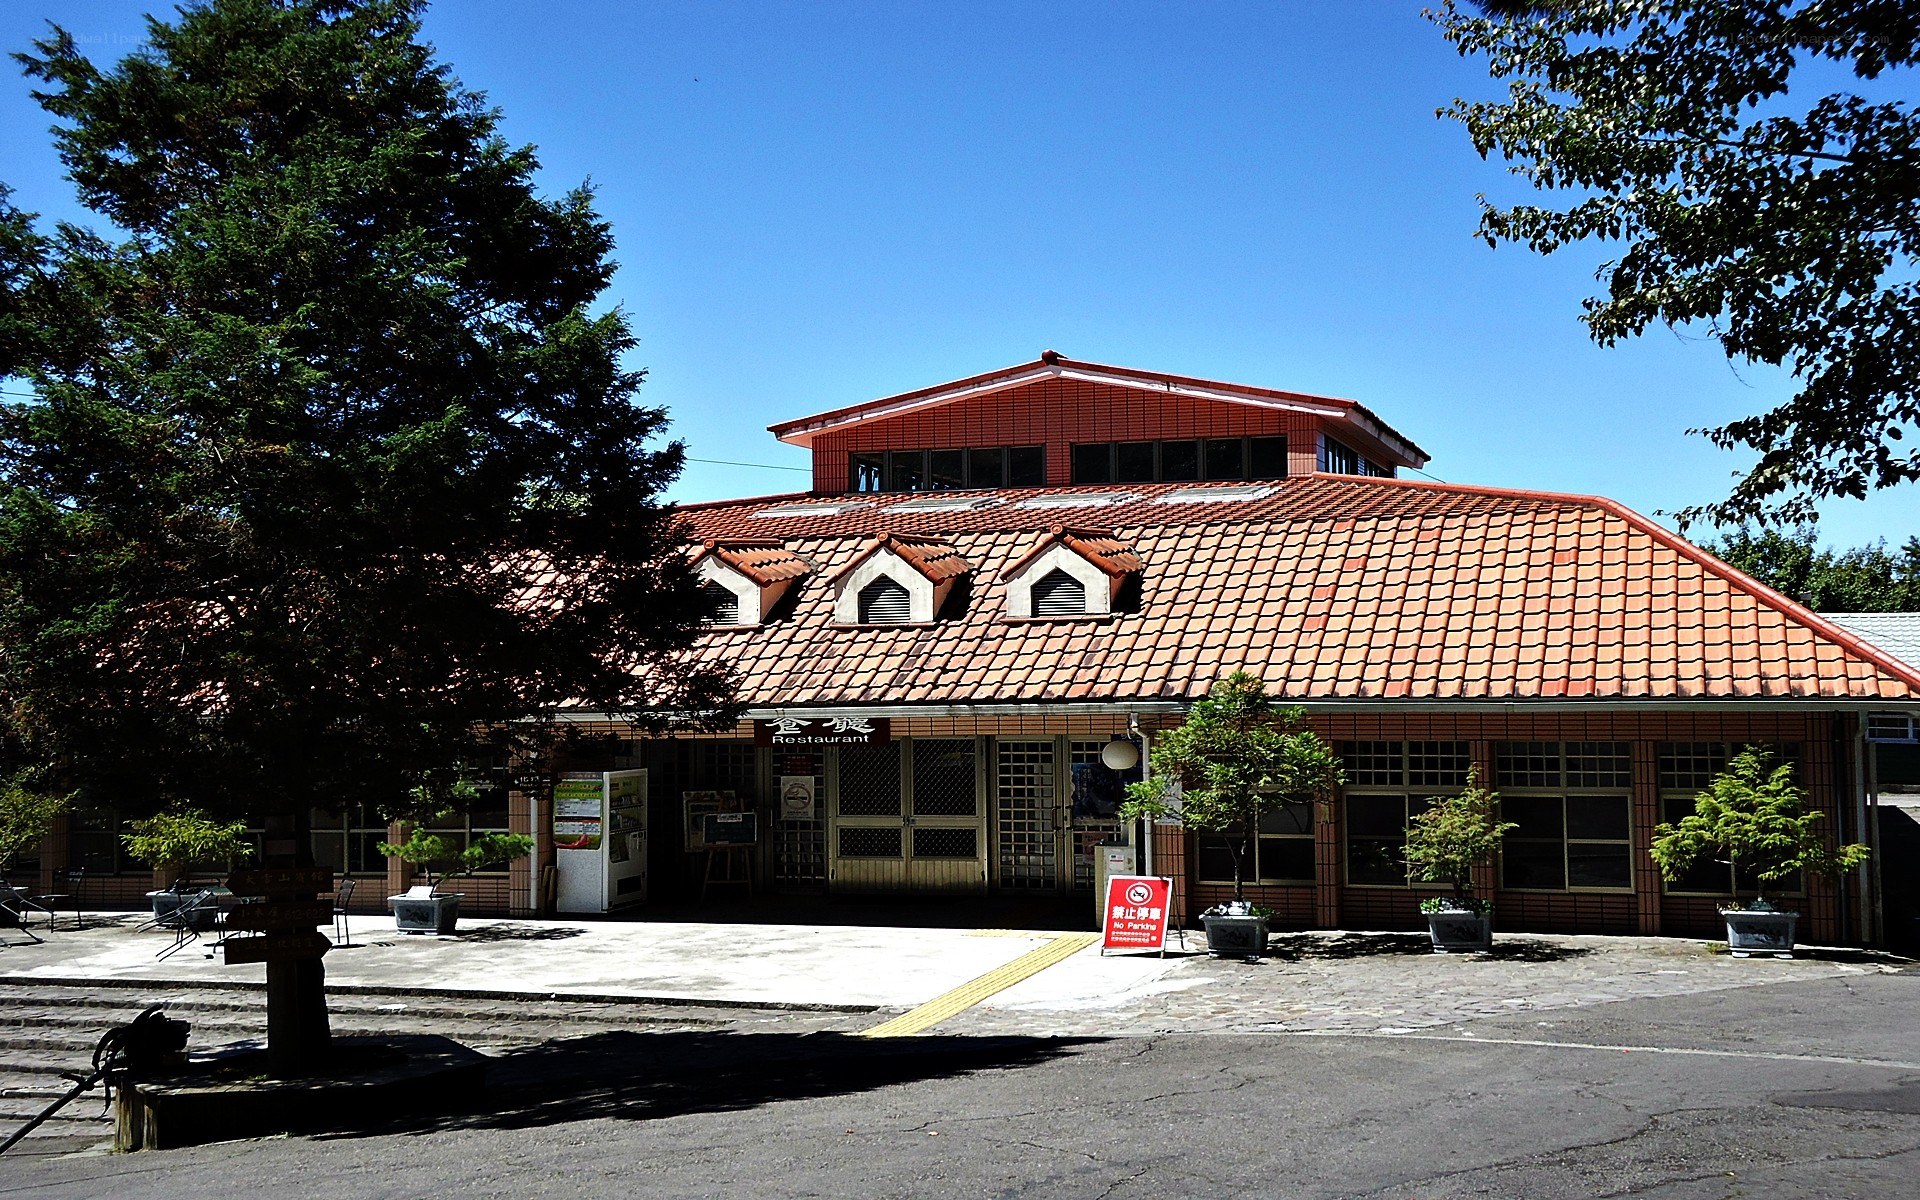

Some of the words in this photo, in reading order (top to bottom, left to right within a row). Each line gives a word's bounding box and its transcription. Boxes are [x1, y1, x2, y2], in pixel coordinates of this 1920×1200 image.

[772, 735, 869, 744] Restaurant
[1112, 906, 1162, 921] 禁止停車
[1113, 921, 1125, 929] No
[1127, 921, 1157, 931] Parking
